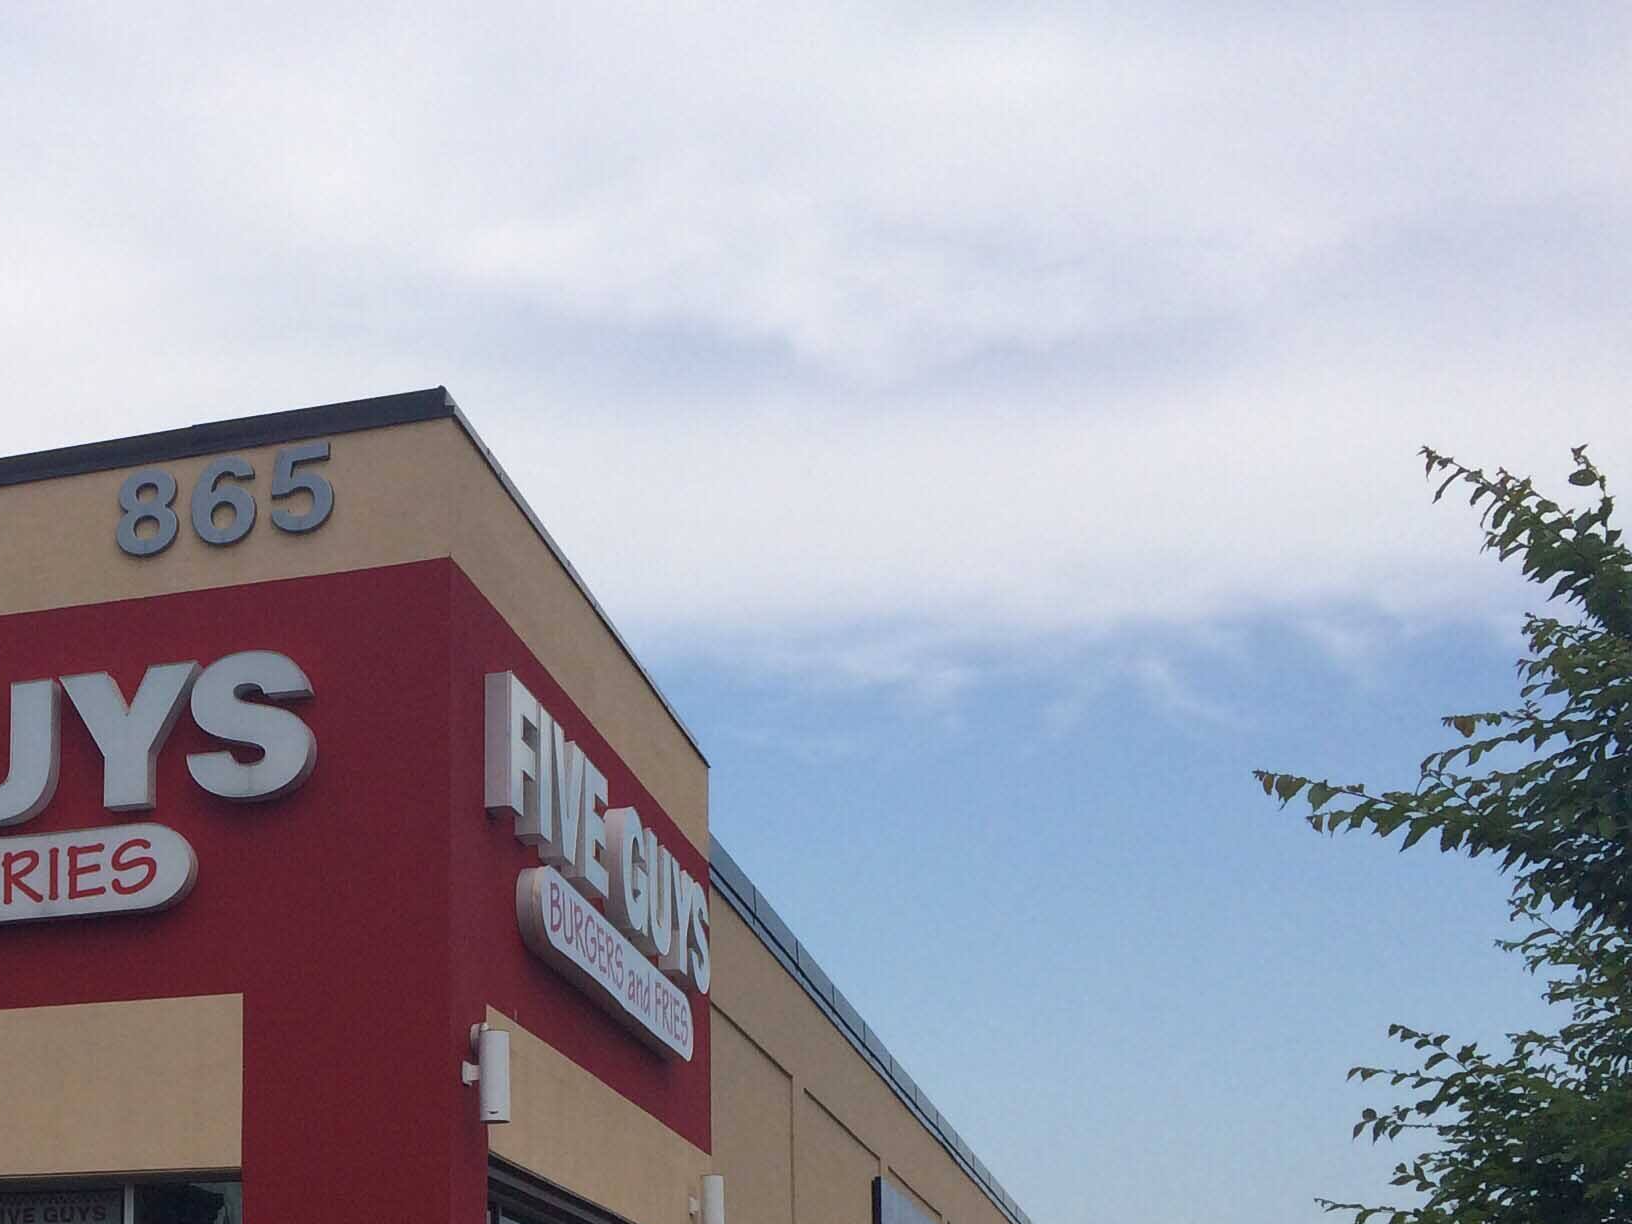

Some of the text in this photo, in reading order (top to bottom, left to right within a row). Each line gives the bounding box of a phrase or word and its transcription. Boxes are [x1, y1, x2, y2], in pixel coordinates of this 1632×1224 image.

[117, 441, 335, 557] 865
[485, 670, 710, 994] FIVE GUYS
[550, 882, 688, 1047] BURGERS and FRIES
[43, 1205, 106, 1223] GUYS
